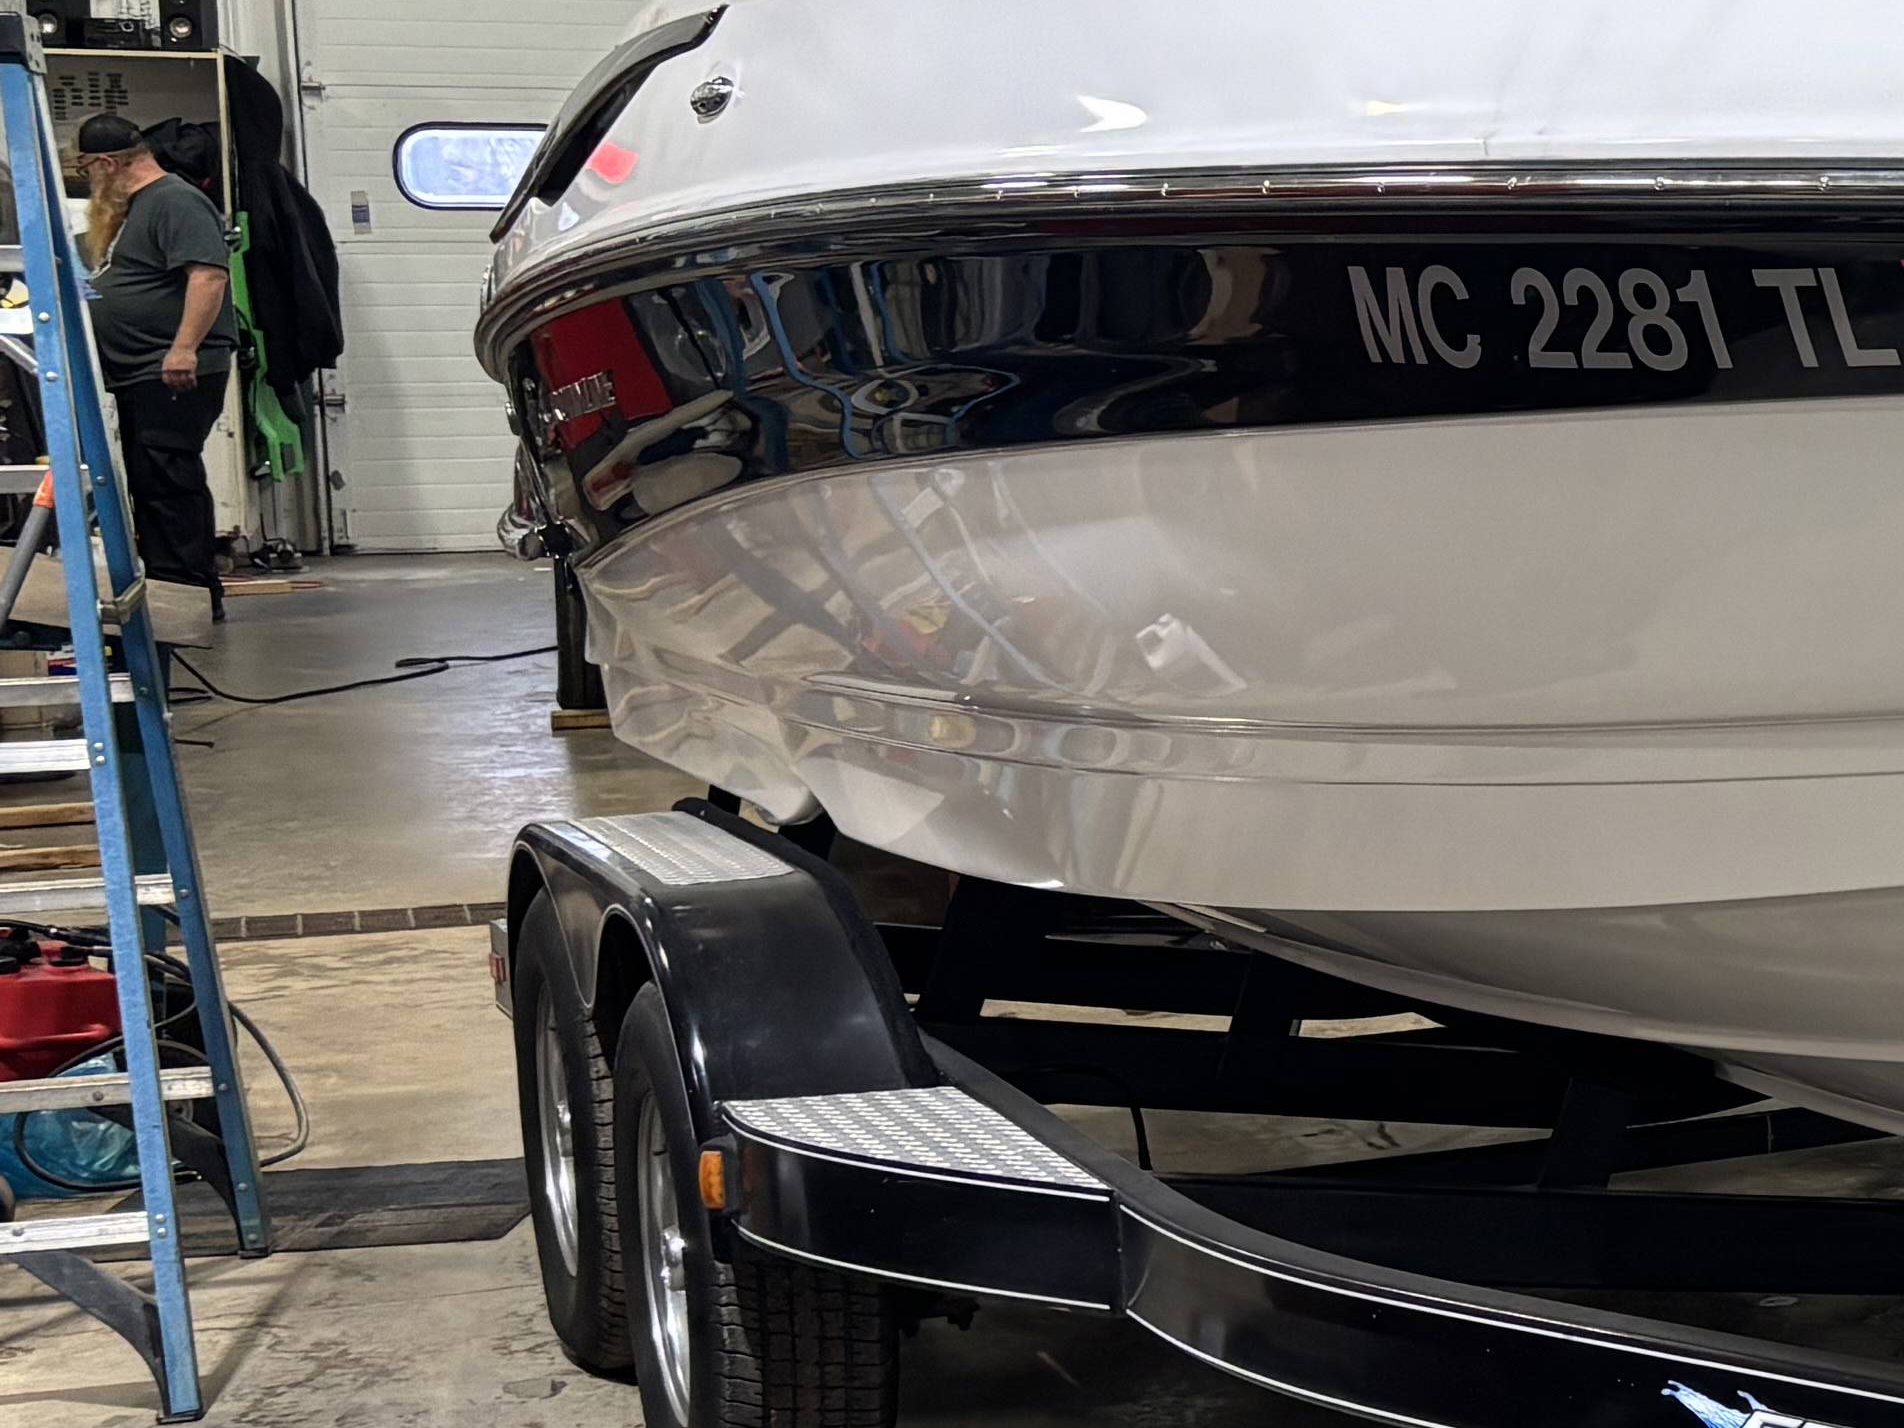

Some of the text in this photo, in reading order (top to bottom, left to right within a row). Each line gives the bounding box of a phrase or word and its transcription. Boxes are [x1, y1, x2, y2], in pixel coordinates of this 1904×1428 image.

[1346, 264, 1903, 372] MC 2281 TL
